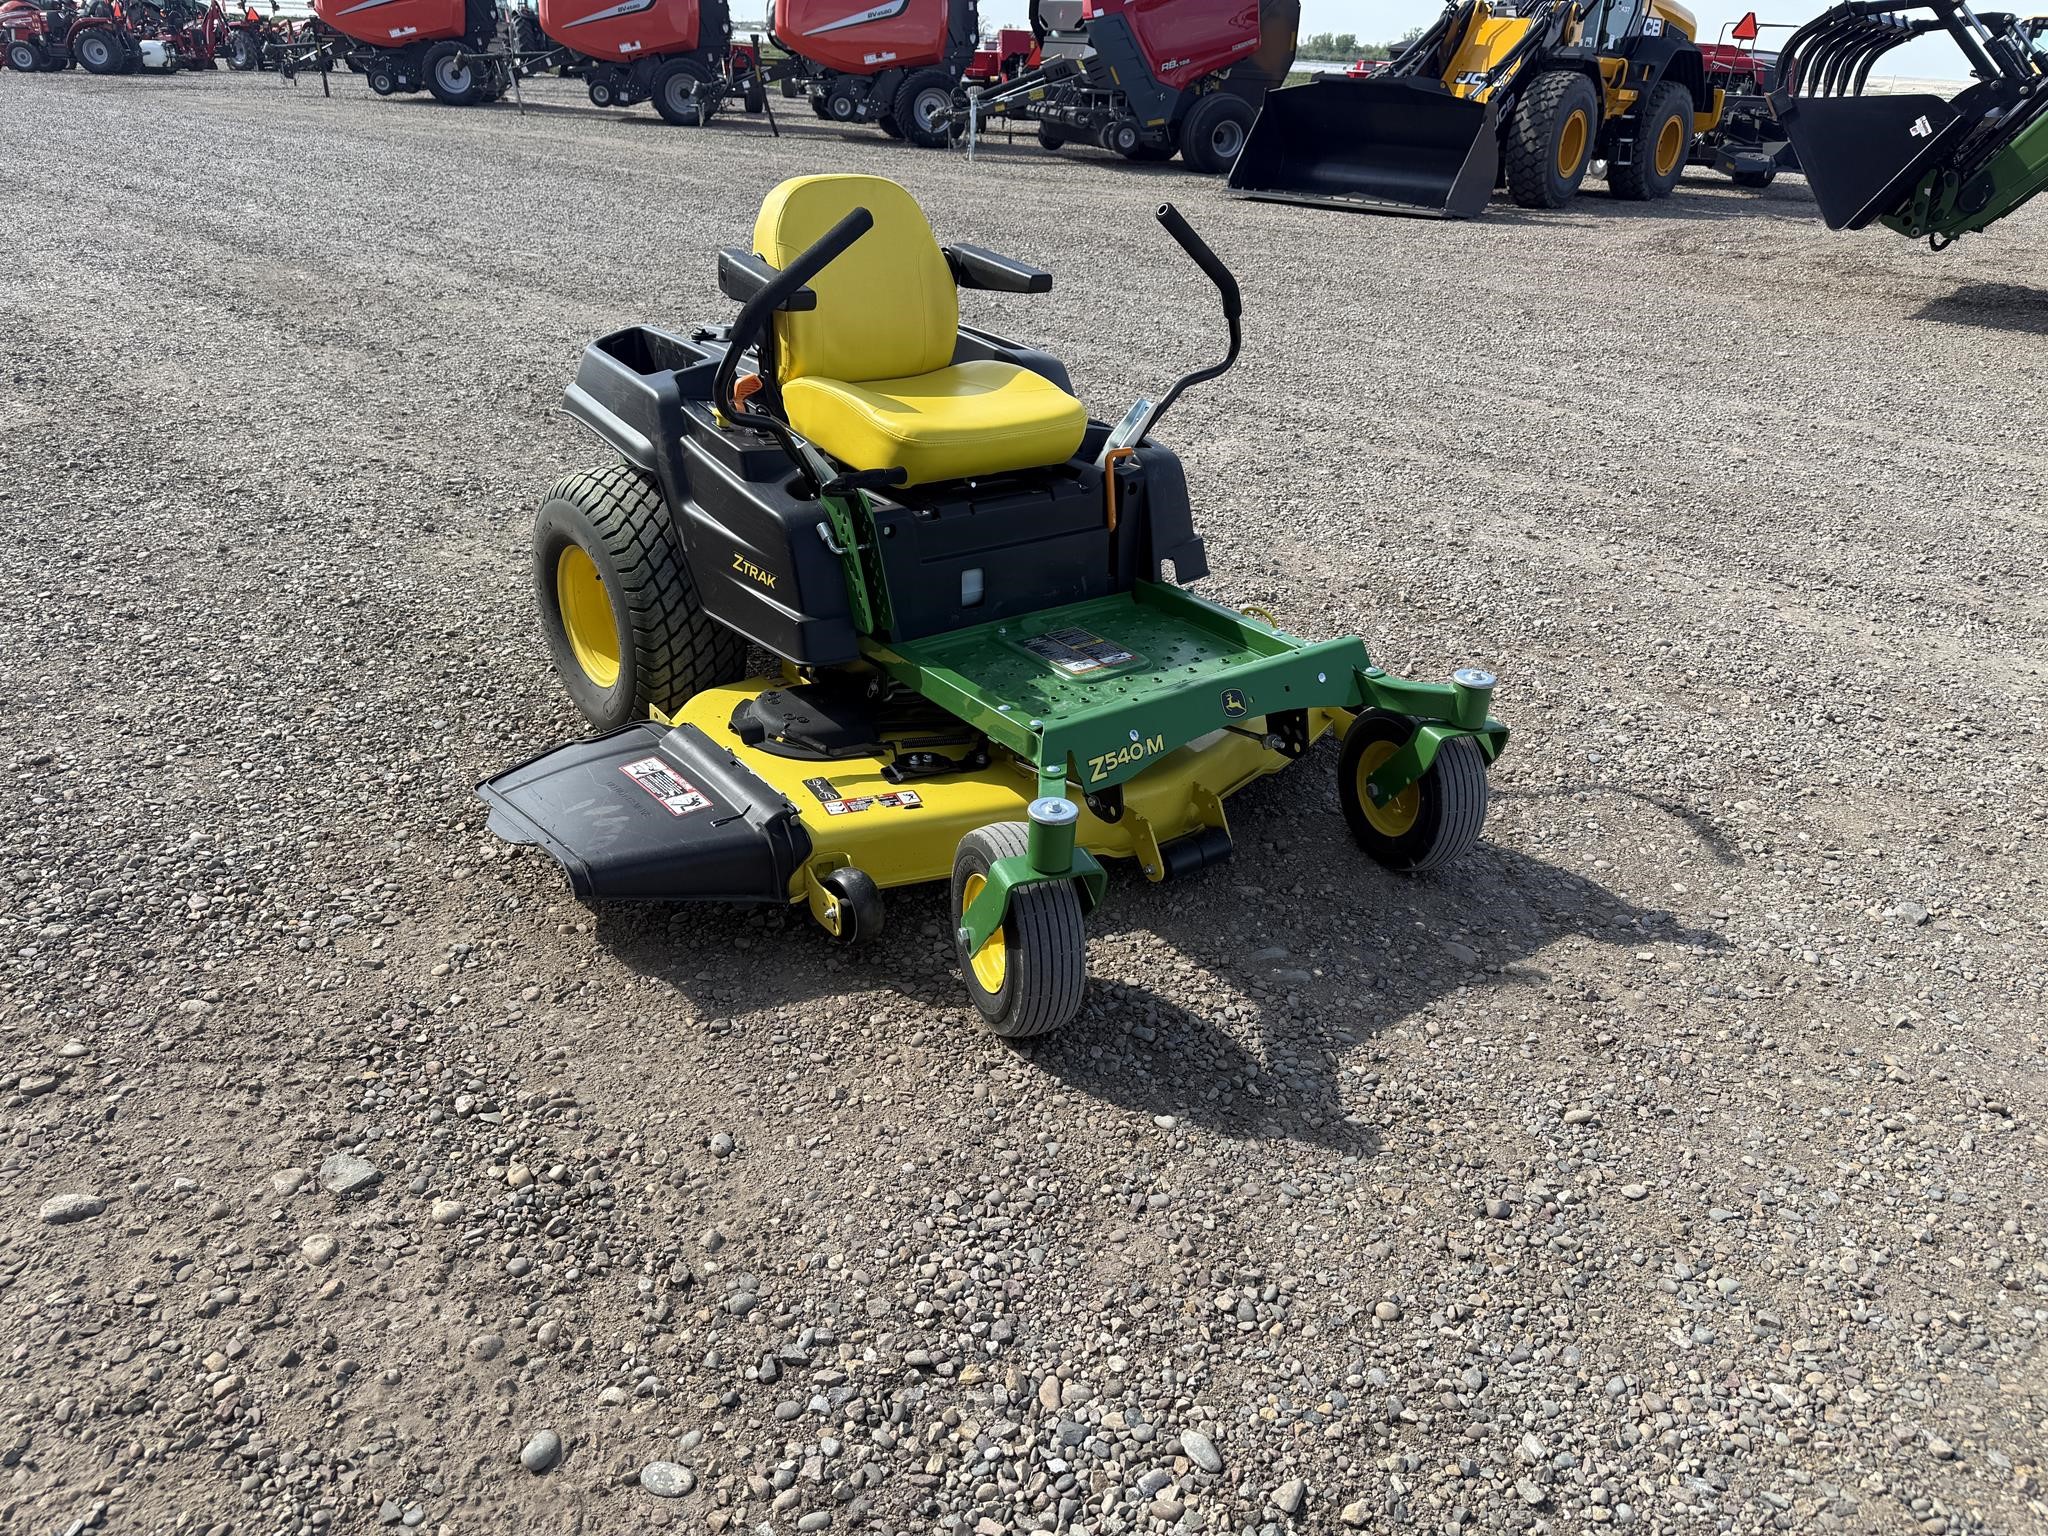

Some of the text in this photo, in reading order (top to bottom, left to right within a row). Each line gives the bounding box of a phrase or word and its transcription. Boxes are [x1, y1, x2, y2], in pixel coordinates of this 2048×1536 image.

[1455, 72, 1489, 85] JC
[1494, 93, 1516, 130] JCB
[732, 553, 777, 589] ZTRAK
[1088, 734, 1165, 783] Z540 M
